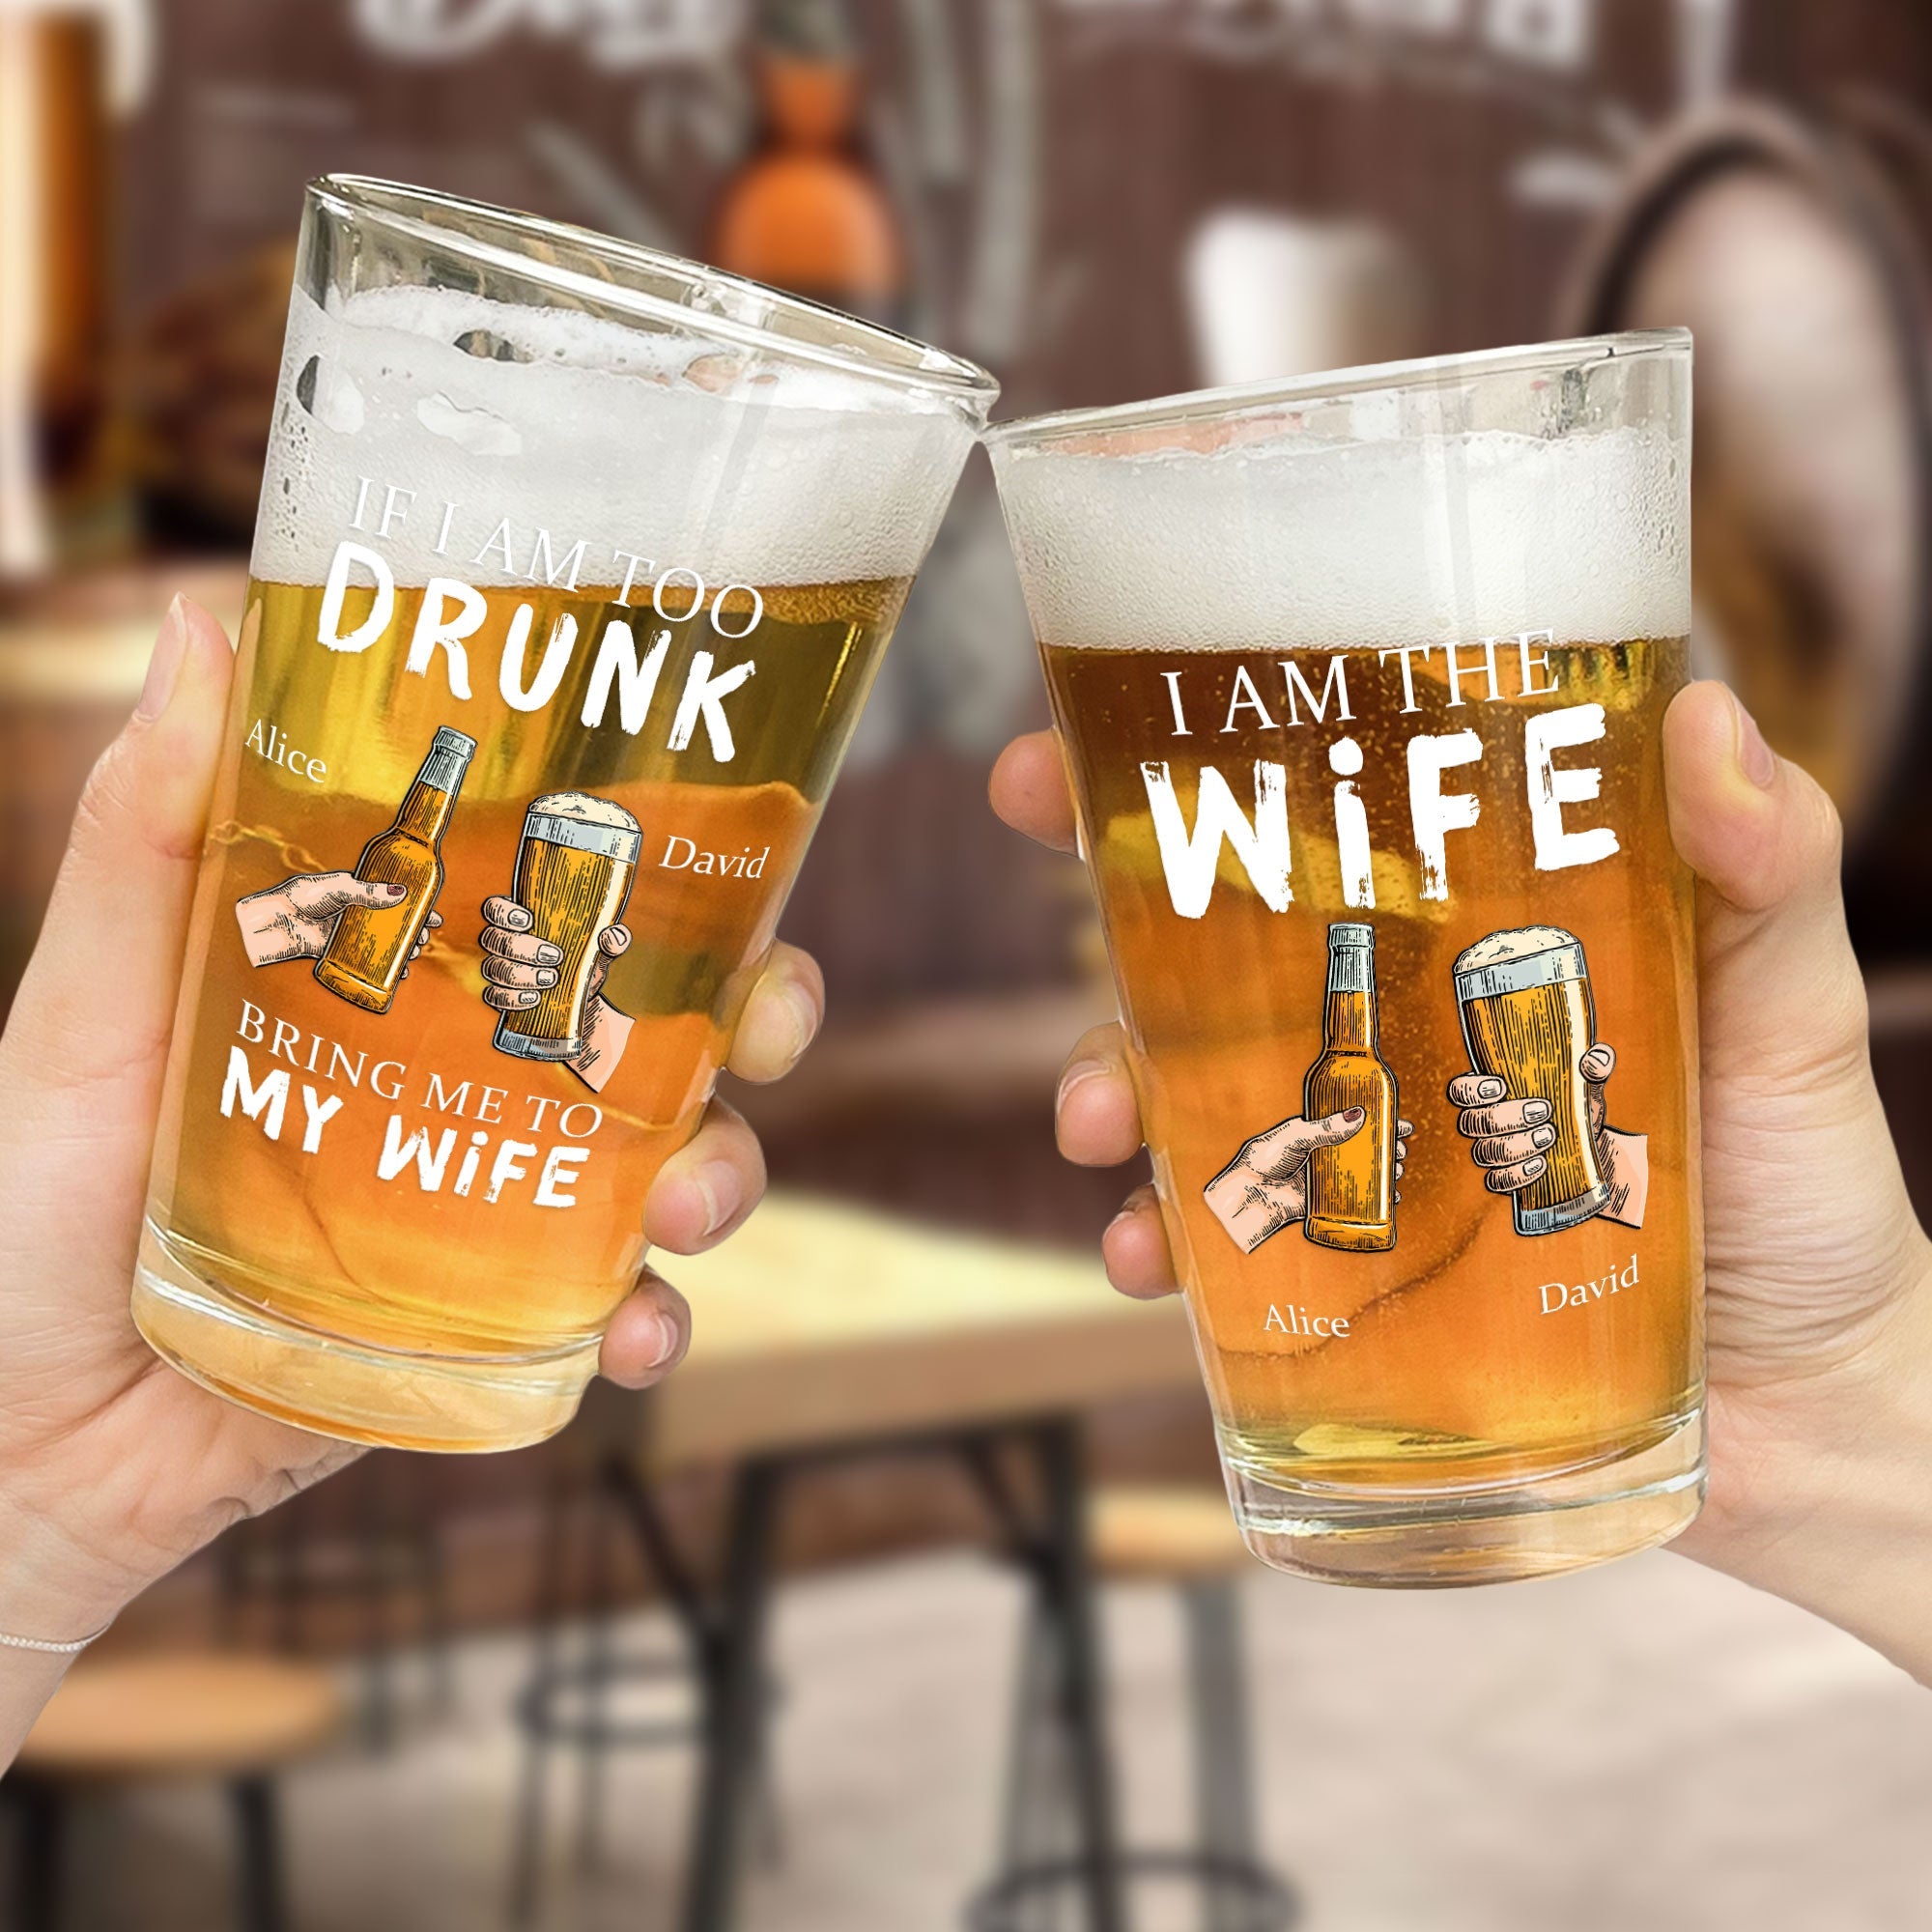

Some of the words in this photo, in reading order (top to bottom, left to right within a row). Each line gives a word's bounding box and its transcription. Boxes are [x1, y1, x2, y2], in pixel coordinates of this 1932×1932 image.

[349, 475, 417, 539] IF
[432, 500, 459, 555] I
[469, 517, 591, 593] AM
[610, 549, 763, 638] TOO
[318, 541, 756, 762] DRUNK
[1160, 671, 1193, 735] I
[1220, 654, 1357, 734] AM
[1378, 628, 1560, 714] THE
[244, 718, 327, 784] Alice
[659, 836, 770, 880] David
[220, 1045, 343, 1153] MY
[236, 999, 407, 1100] BRING
[420, 1073, 508, 1122] ME
[526, 1095, 603, 1138] TO
[1264, 1304, 1350, 1338] Alice
[1538, 1254, 1639, 1315] David
